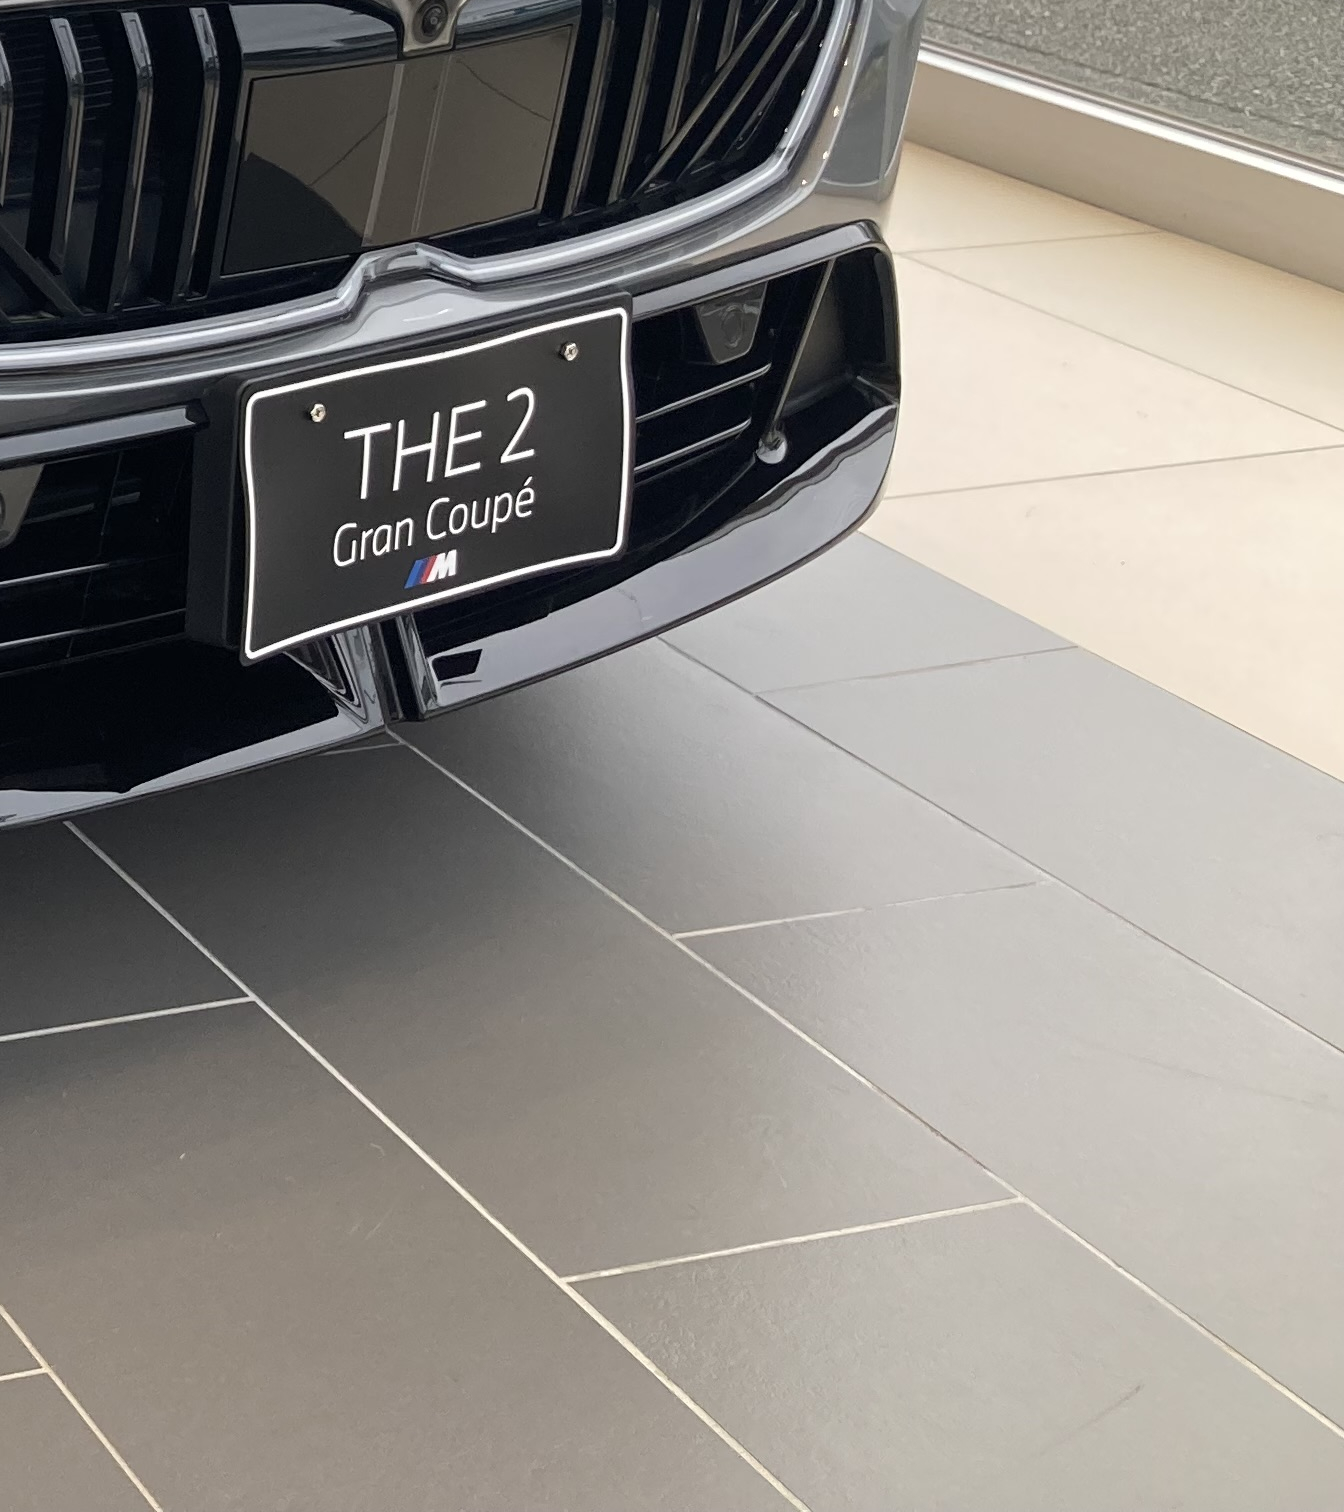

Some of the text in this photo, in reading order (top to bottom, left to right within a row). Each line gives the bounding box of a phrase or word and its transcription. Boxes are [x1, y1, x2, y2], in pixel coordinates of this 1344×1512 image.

[343, 387, 536, 500] THE 2
[332, 476, 535, 568] Gran Coupé
[426, 549, 457, 583] M
